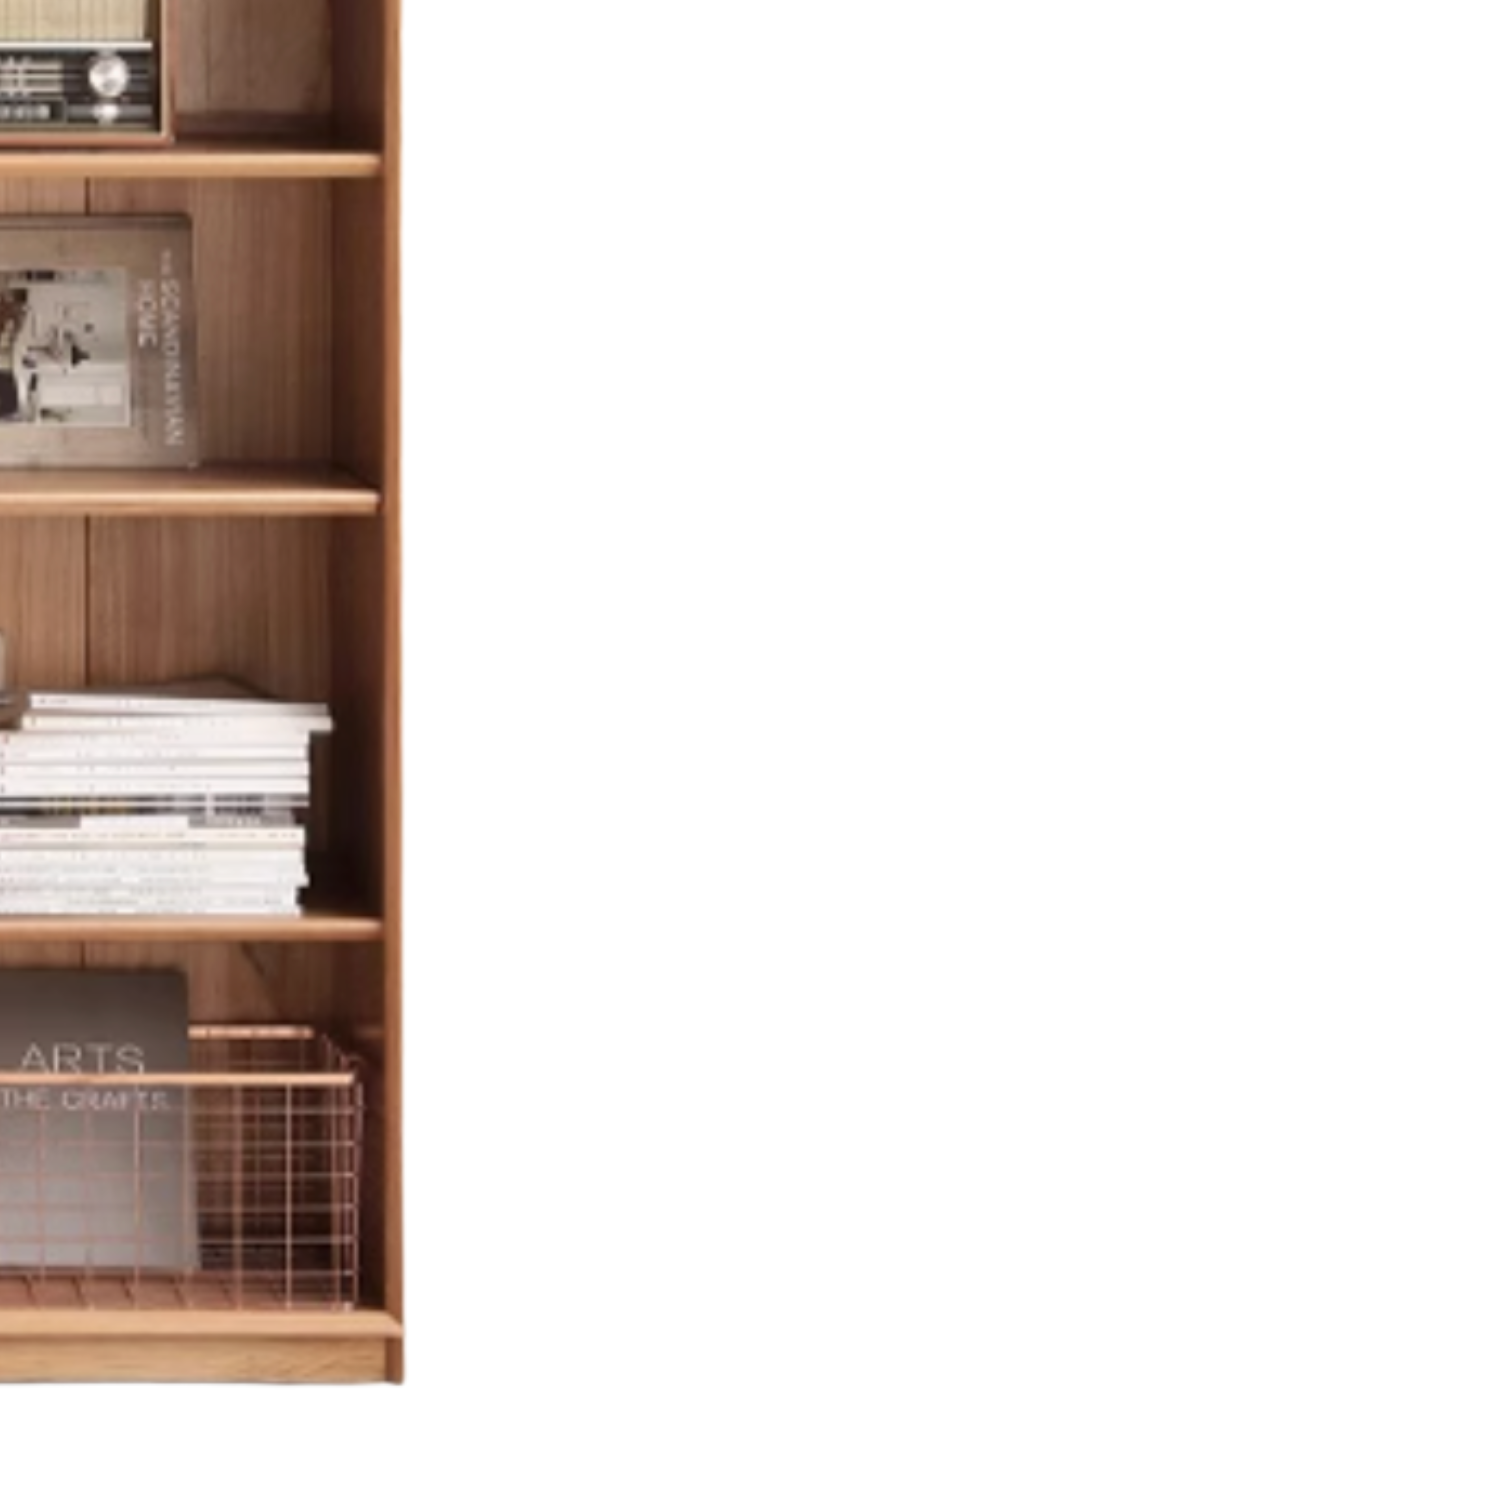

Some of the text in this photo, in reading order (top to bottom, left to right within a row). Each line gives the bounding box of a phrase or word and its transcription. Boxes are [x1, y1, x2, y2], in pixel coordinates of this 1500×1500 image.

[138, 279, 158, 348] HOME
[20, 1042, 146, 1074] ARTS
[0, 1087, 50, 1110] THE
